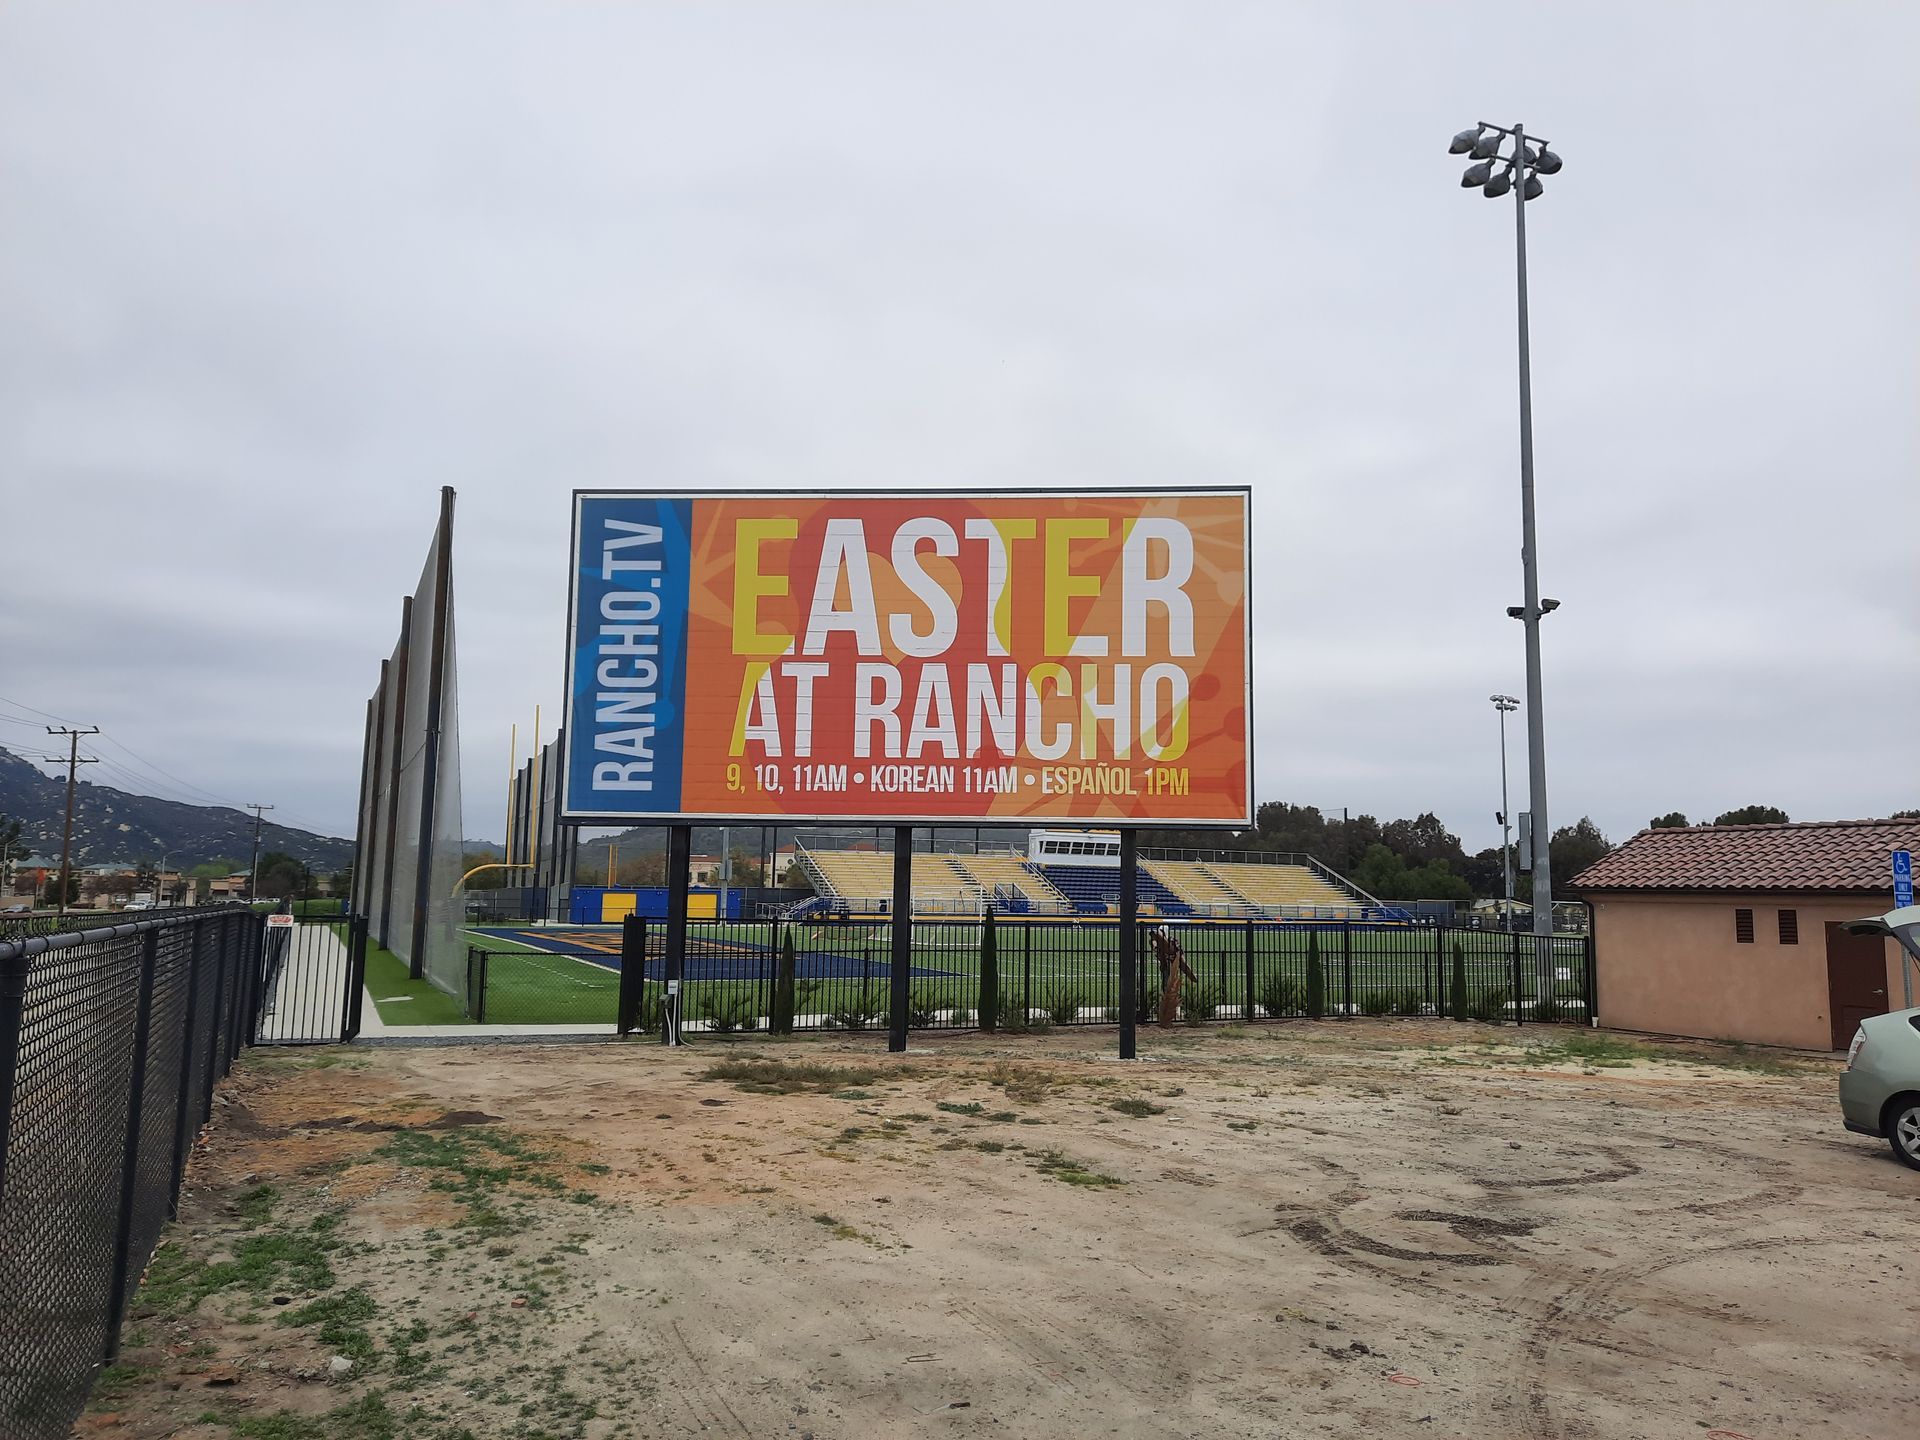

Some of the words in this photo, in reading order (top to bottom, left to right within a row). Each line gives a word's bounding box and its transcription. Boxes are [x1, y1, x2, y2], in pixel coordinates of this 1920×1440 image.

[732, 517, 1196, 658] EASTER
[592, 519, 663, 791] RANCHO.TV
[728, 662, 830, 758] AT
[854, 662, 1190, 761] RANCHO
[726, 763, 745, 794] 9,
[754, 763, 784, 795] 10,
[792, 764, 847, 792] 11AM
[870, 764, 955, 793] KOREAN
[962, 765, 1018, 794] 11AM
[1041, 762, 1137, 795] ESPAÑOL
[1144, 767, 1189, 796] 1PM
